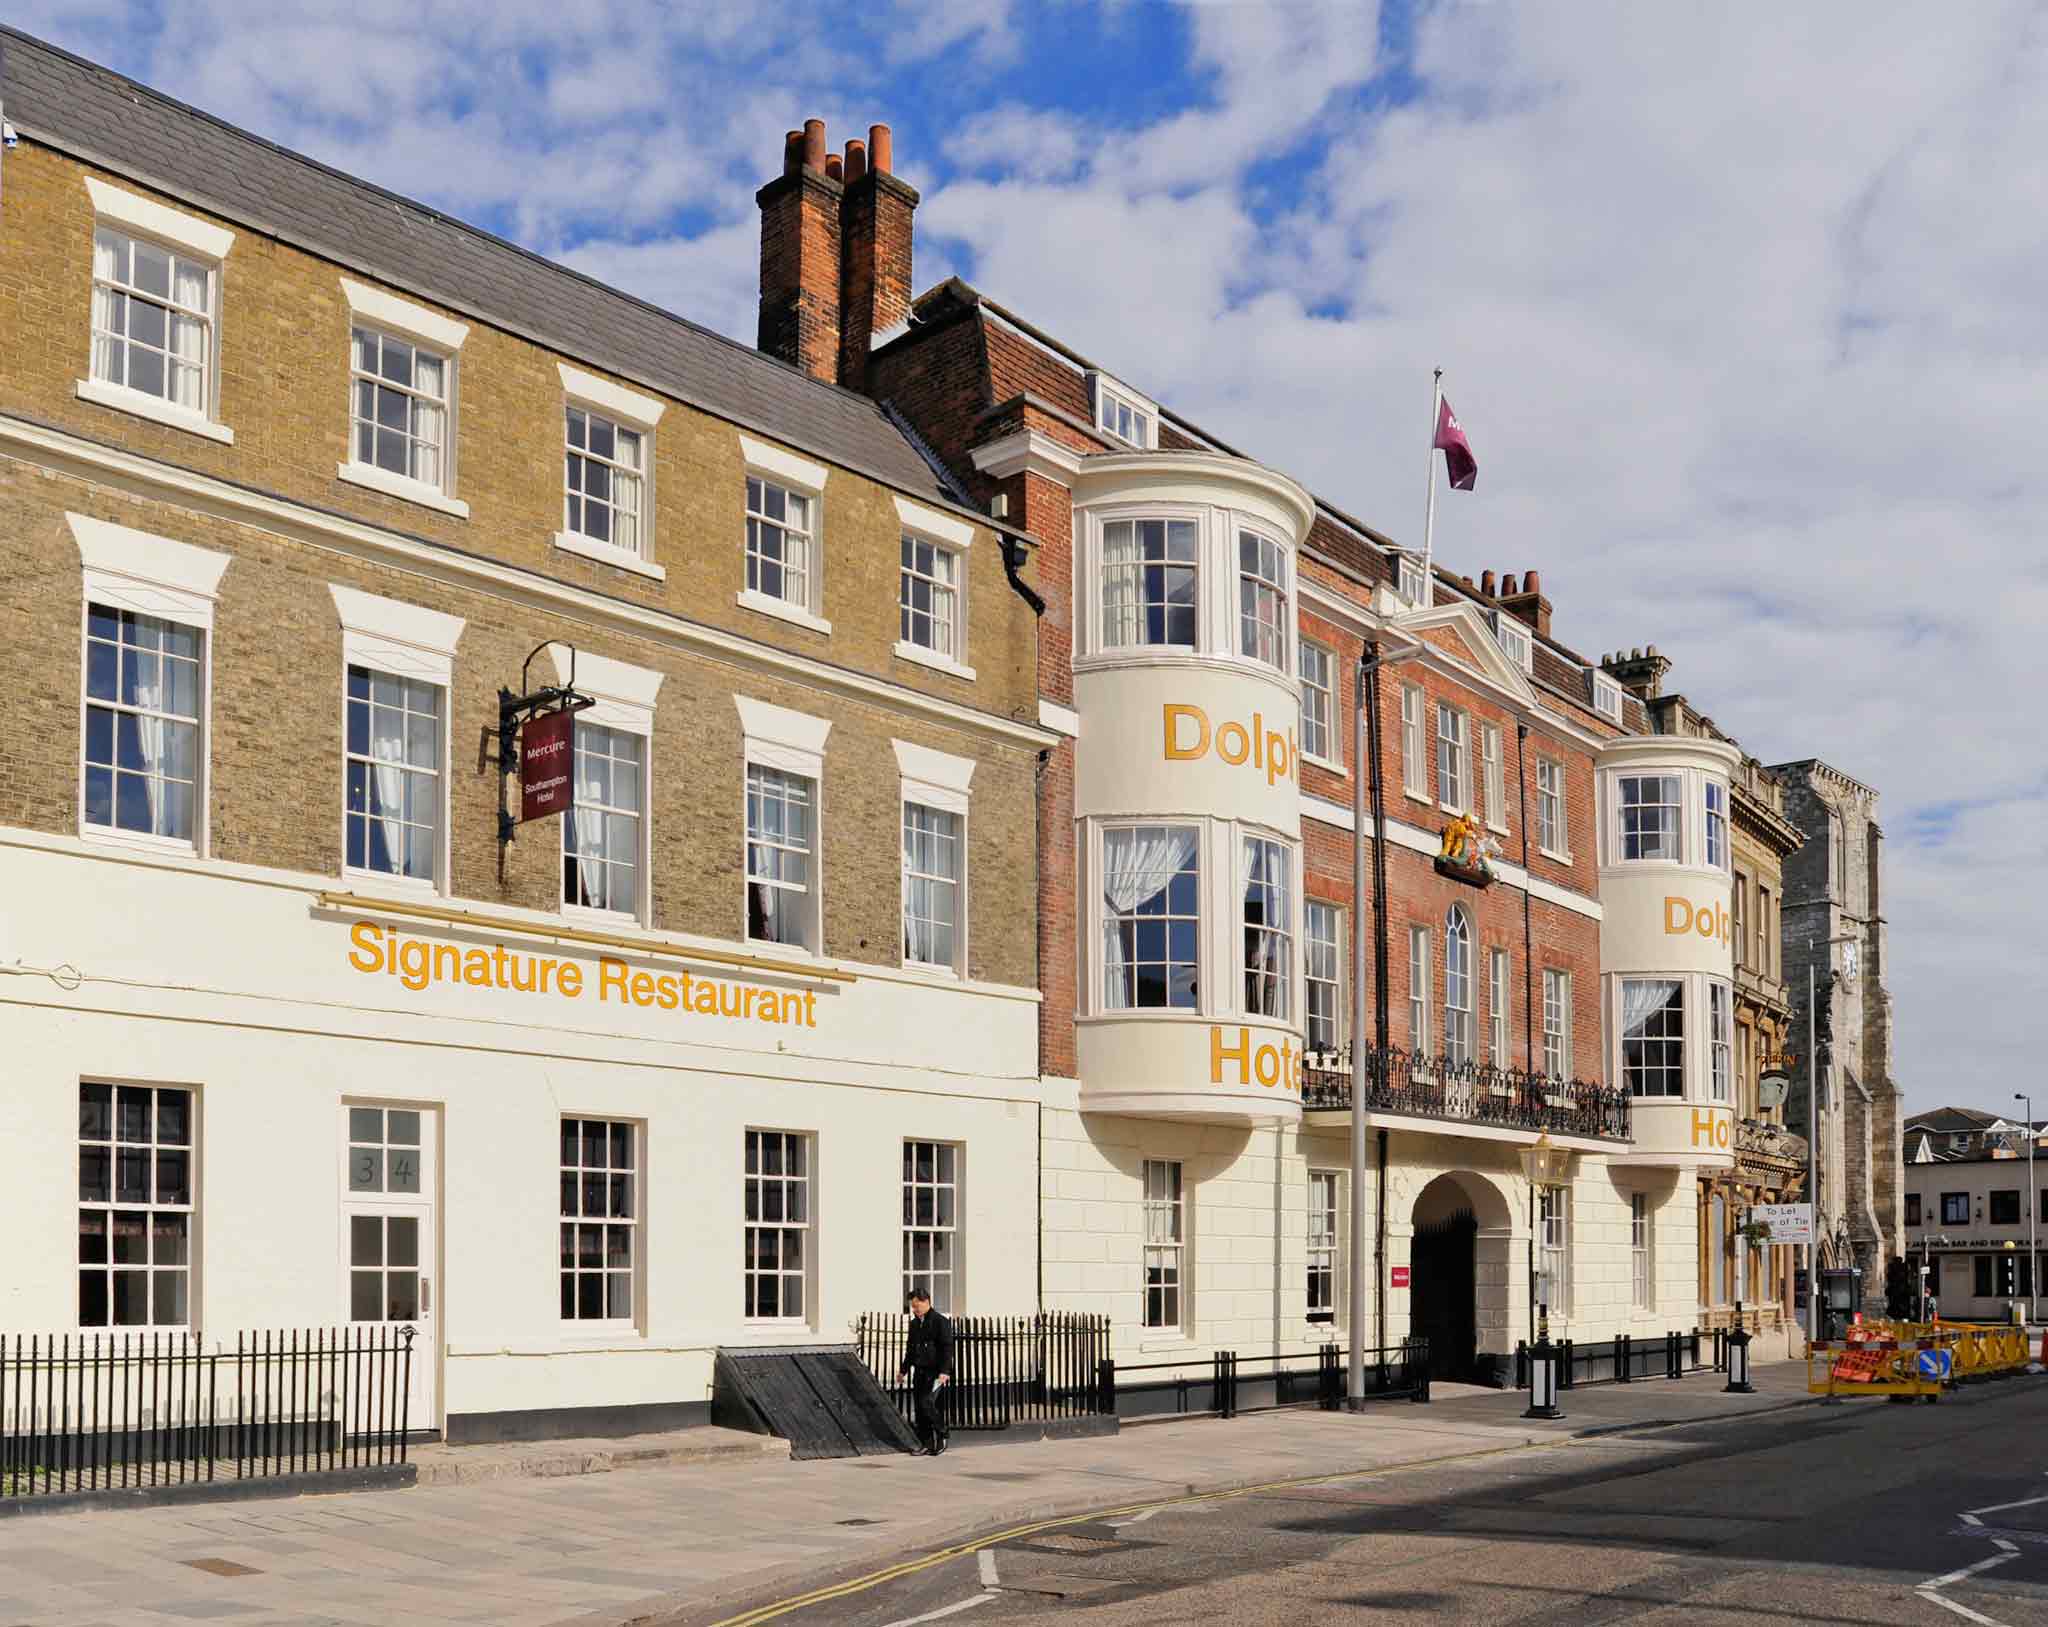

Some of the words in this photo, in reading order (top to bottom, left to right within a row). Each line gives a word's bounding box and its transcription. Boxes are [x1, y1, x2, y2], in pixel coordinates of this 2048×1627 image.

[527, 740, 565, 759] Mercure
[525, 776, 567, 793] Southampton
[536, 791, 554, 804] Hotel
[349, 920, 583, 998] Signature
[600, 956, 816, 1028] Restaurant
[1767, 1207, 1777, 1216] To
[1970, 1239, 1988, 1248] AND
